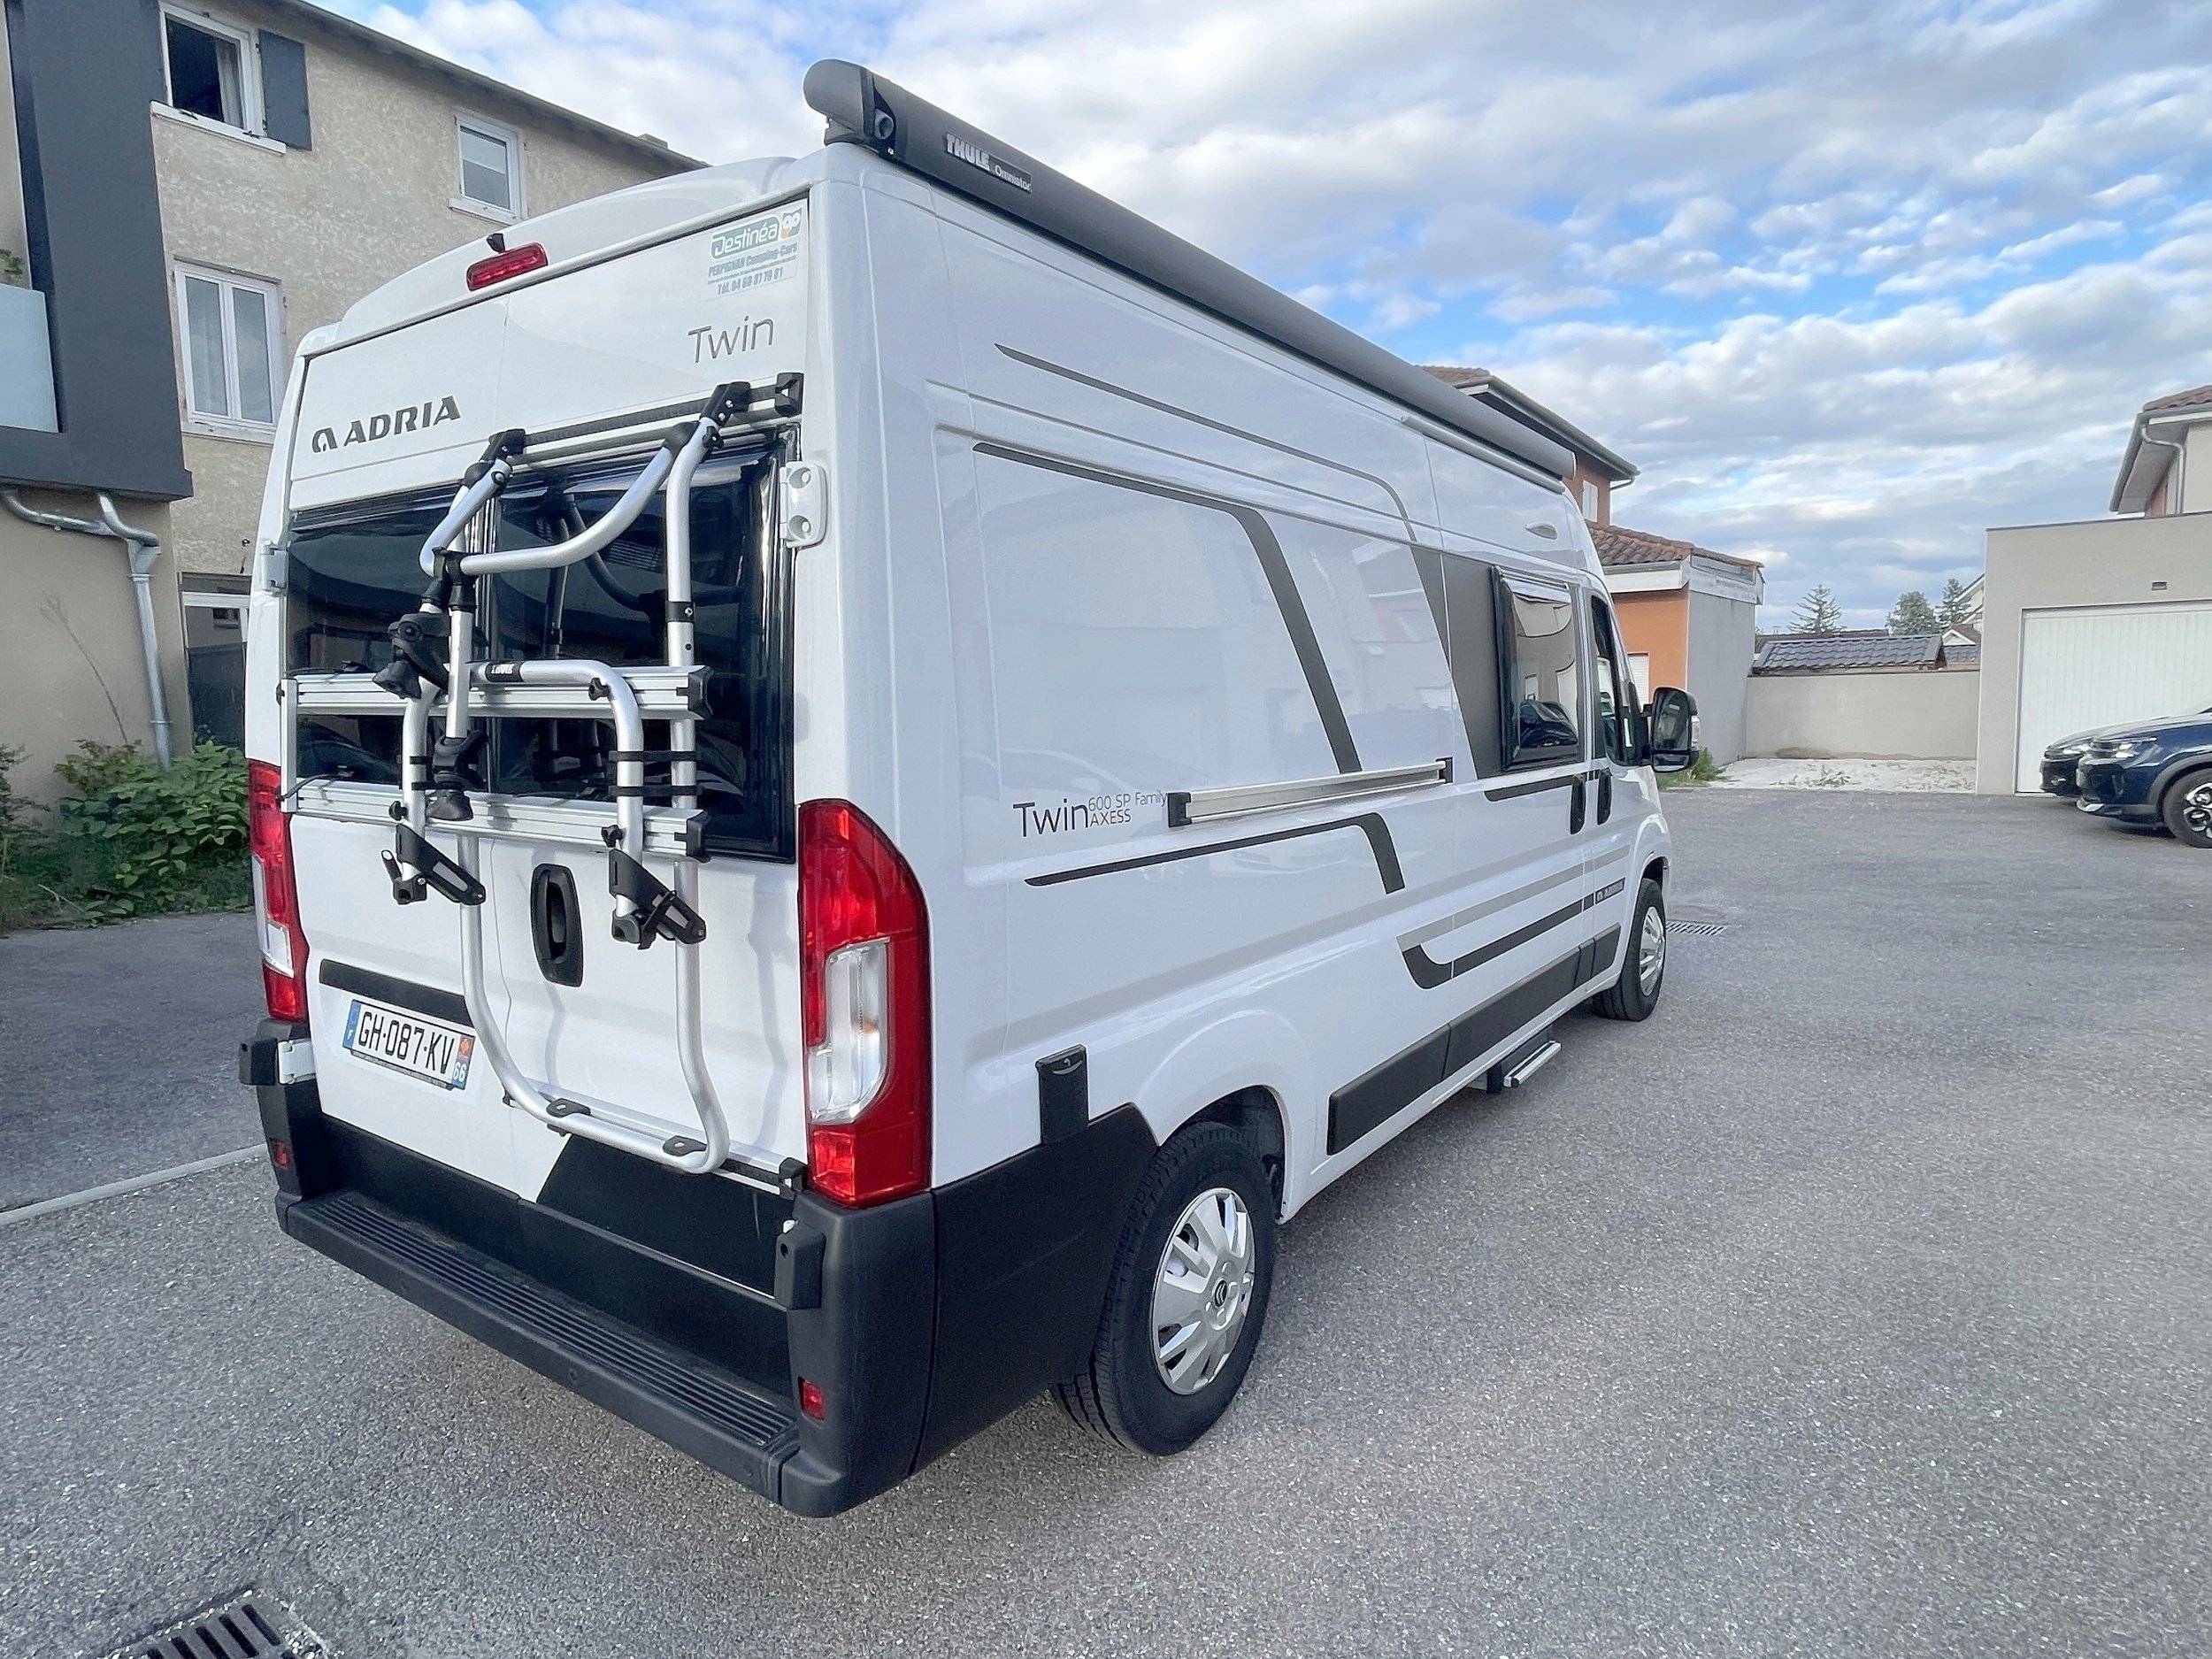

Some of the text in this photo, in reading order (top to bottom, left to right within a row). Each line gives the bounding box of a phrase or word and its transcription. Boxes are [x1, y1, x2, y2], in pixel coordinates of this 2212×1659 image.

[947, 133, 990, 172] THULE
[711, 222, 779, 257] Destinéa
[688, 315, 773, 363] Twin
[343, 396, 461, 448] ADRIA
[1013, 789, 1167, 837] Twin 600 SP Family
[1089, 809, 1131, 827] AXESS
[358, 1011, 455, 1074] GH-087-KV
[454, 1062, 467, 1083] 66
